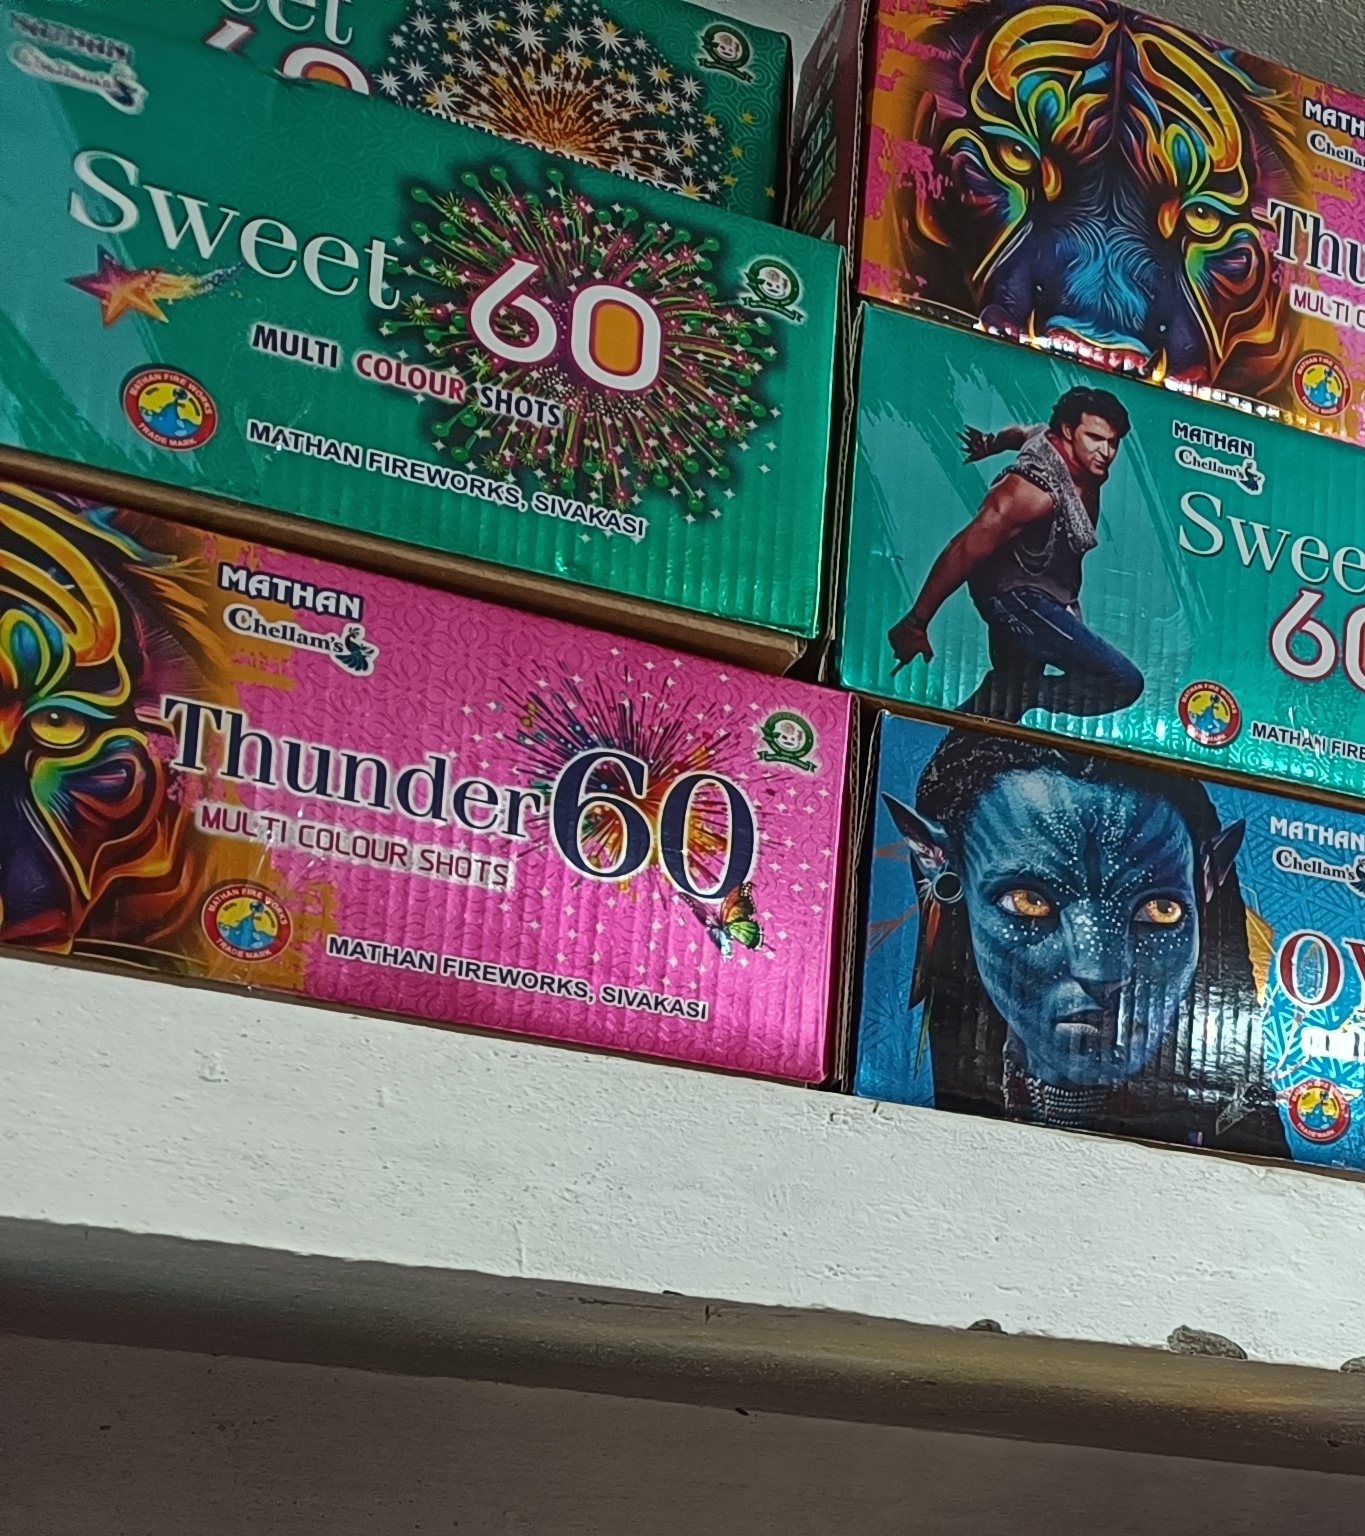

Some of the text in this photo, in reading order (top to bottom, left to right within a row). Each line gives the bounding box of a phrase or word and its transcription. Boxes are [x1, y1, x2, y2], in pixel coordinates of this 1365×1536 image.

[67, 148, 401, 312] Sweet
[465, 259, 665, 392] 60
[1291, 290, 1352, 326] MULTI
[251, 322, 564, 429] MULTI COLOUR SHOTS
[1173, 421, 1254, 457] MATHAN
[1177, 446, 1245, 482] Chellam's
[248, 421, 647, 538] MATHAN FIREWORKS, SIVAKASI
[220, 563, 363, 620] MATHAN
[227, 606, 347, 653] Chellam's
[161, 696, 542, 839] Thunder
[1251, 722, 1327, 754] MATHAN
[202, 807, 509, 887] MULTI COLOUR SHOTS
[550, 749, 758, 901] 60
[1273, 849, 1355, 883] Chellam's
[216, 938, 272, 958] TRADE MARK
[327, 936, 709, 1021] MATHAN FIREWORKS, SIVAKASI
